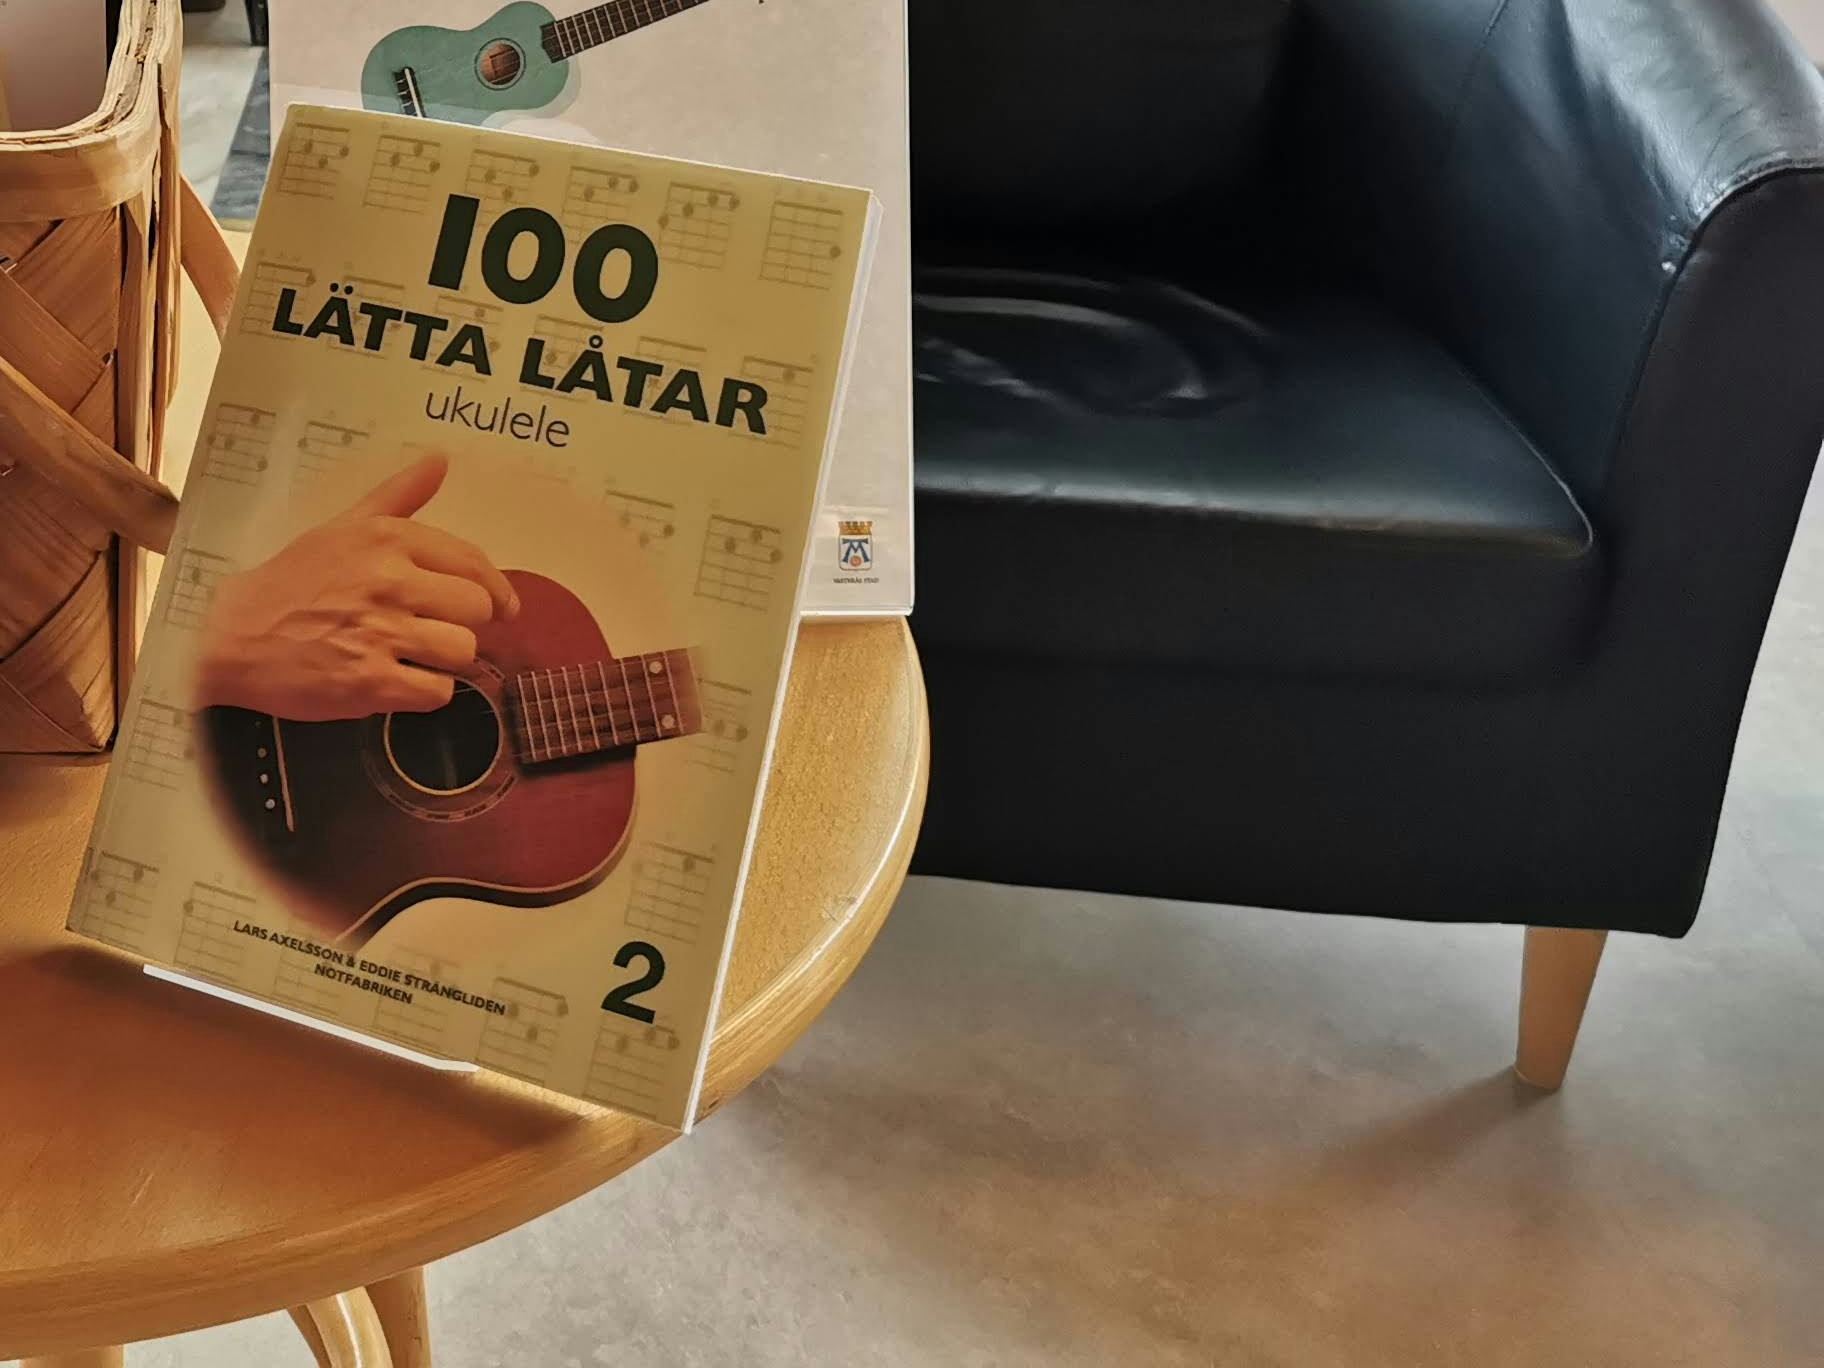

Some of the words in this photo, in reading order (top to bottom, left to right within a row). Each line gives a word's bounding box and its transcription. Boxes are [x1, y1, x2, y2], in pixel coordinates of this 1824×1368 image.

[427, 192, 659, 324] 100
[271, 282, 493, 377] LÄTTA
[518, 334, 768, 436] LÅTAR
[424, 385, 570, 448] ukulele
[233, 919, 268, 940] LARS
[269, 932, 344, 965] AXELSSON
[345, 953, 356, 968] &
[359, 959, 401, 984] EDDIE
[314, 963, 414, 1005] NOTFABRIKEN
[601, 940, 666, 1024] 2
